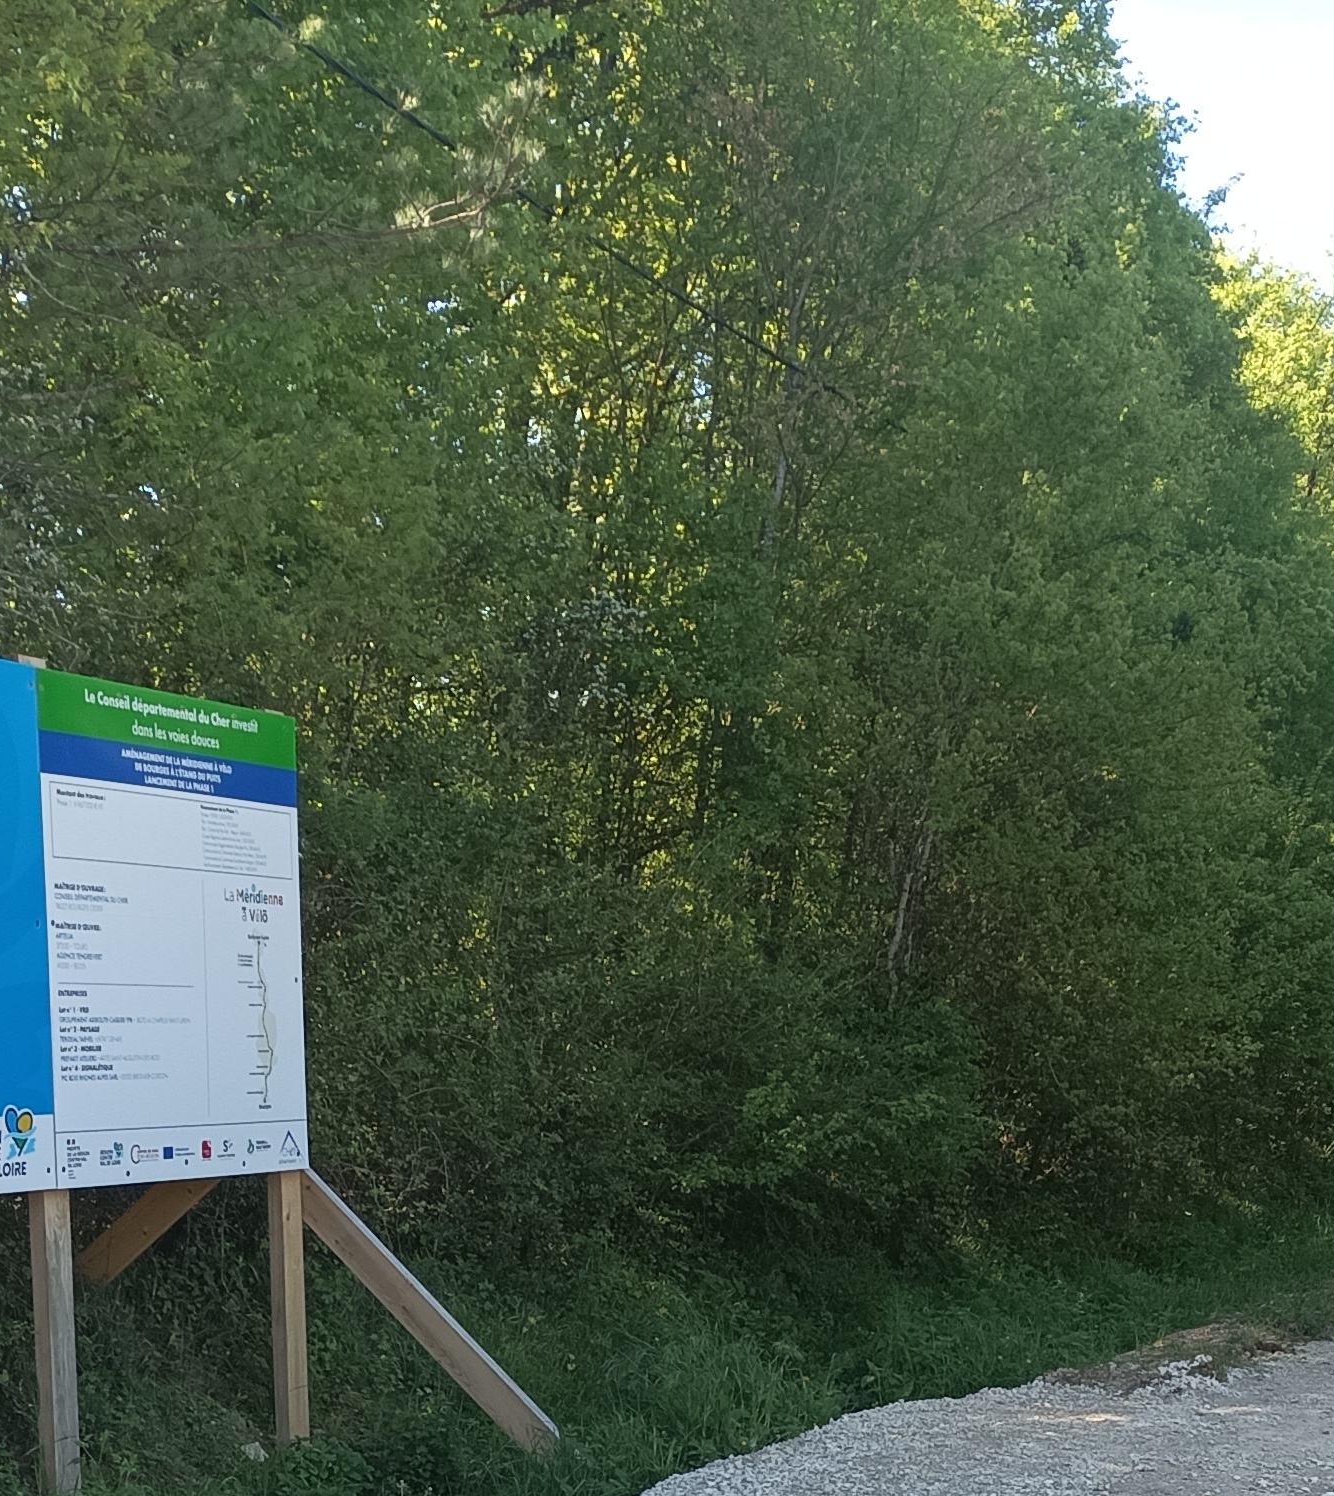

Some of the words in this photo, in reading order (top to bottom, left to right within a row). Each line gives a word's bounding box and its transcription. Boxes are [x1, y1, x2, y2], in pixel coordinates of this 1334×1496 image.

[85, 689, 95, 704] Le
[97, 692, 130, 711] Conseil
[132, 699, 196, 723] départemental
[198, 711, 209, 725] du
[211, 712, 230, 728] Cher
[232, 717, 258, 733] investit
[132, 720, 152, 737] dans
[154, 723, 166, 739] les
[168, 729, 189, 744] voies
[191, 730, 219, 749] douces
[224, 888, 234, 902] La
